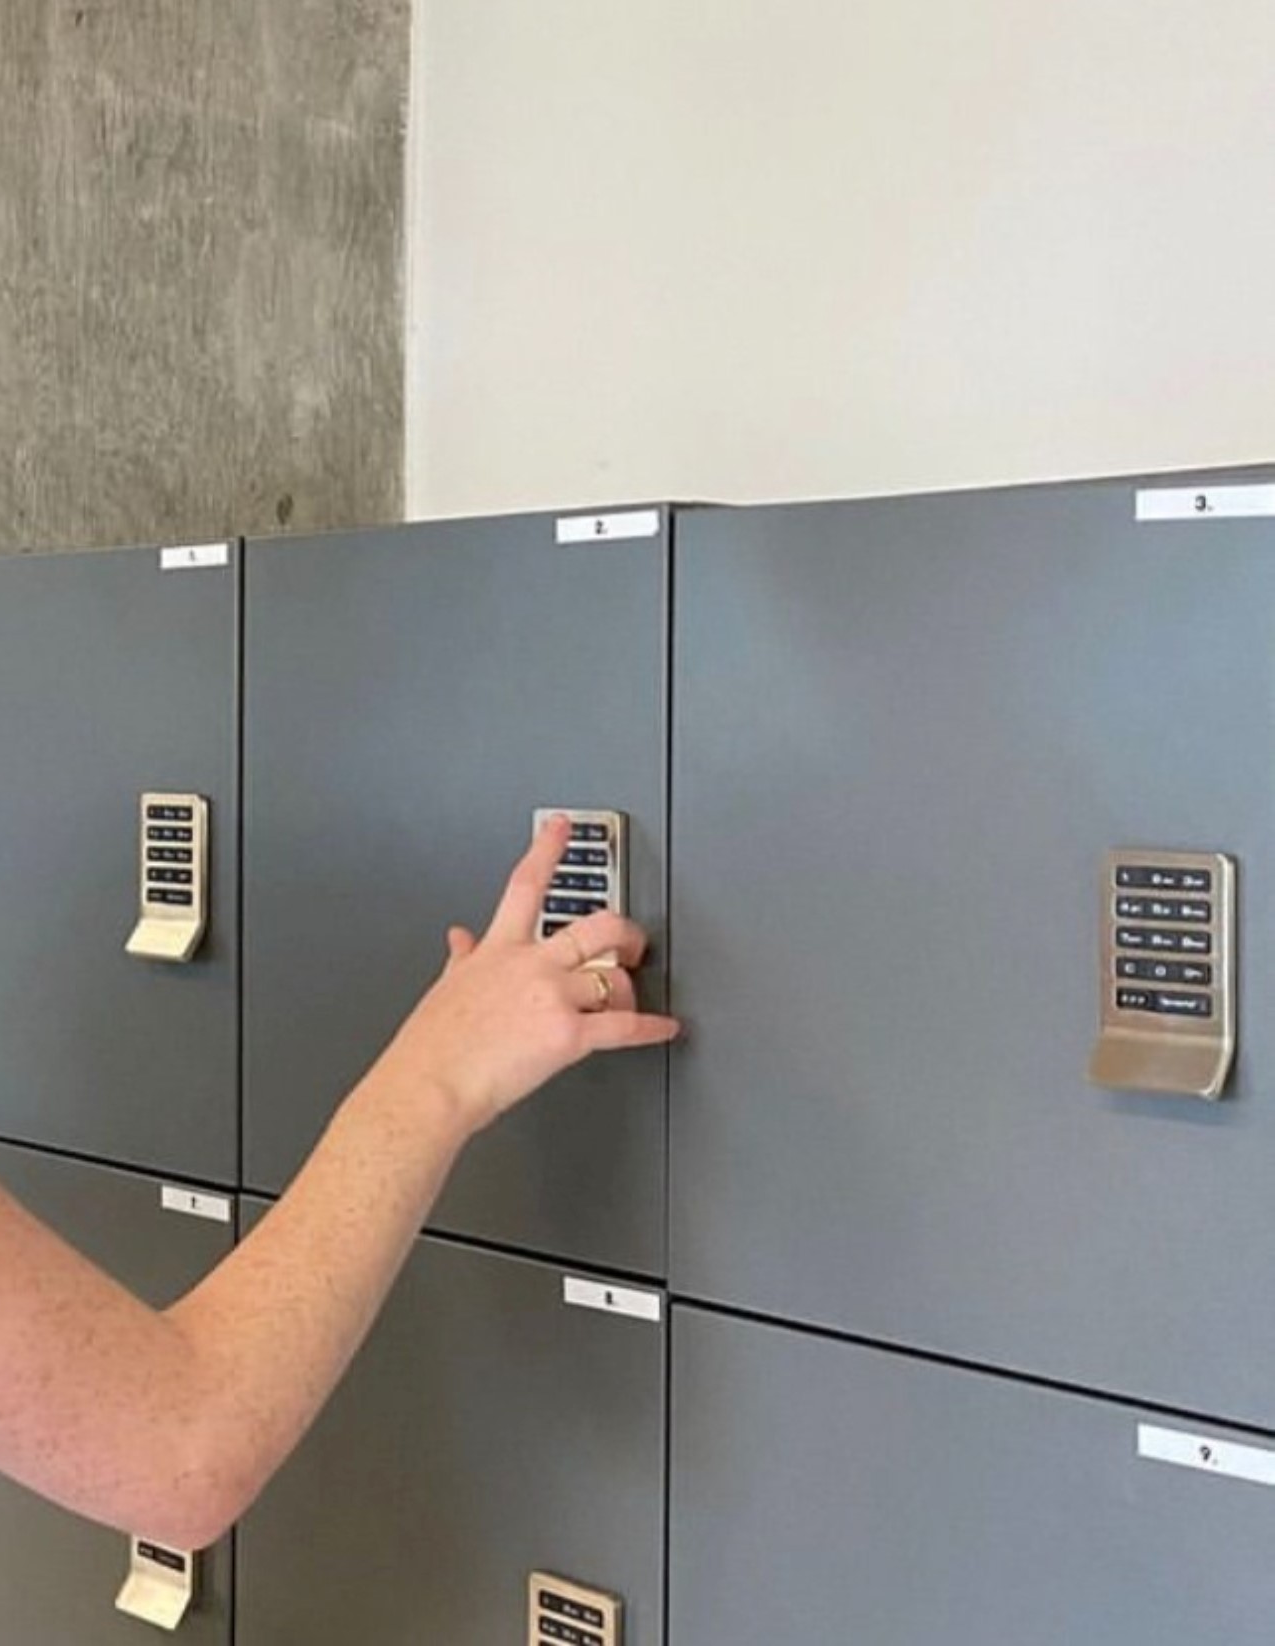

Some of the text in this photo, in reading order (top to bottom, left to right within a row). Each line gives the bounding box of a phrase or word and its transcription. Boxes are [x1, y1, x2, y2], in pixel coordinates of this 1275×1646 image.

[1195, 494, 1215, 512] 3.
[594, 518, 609, 535] 2.
[1199, 1445, 1218, 1465] 9.
